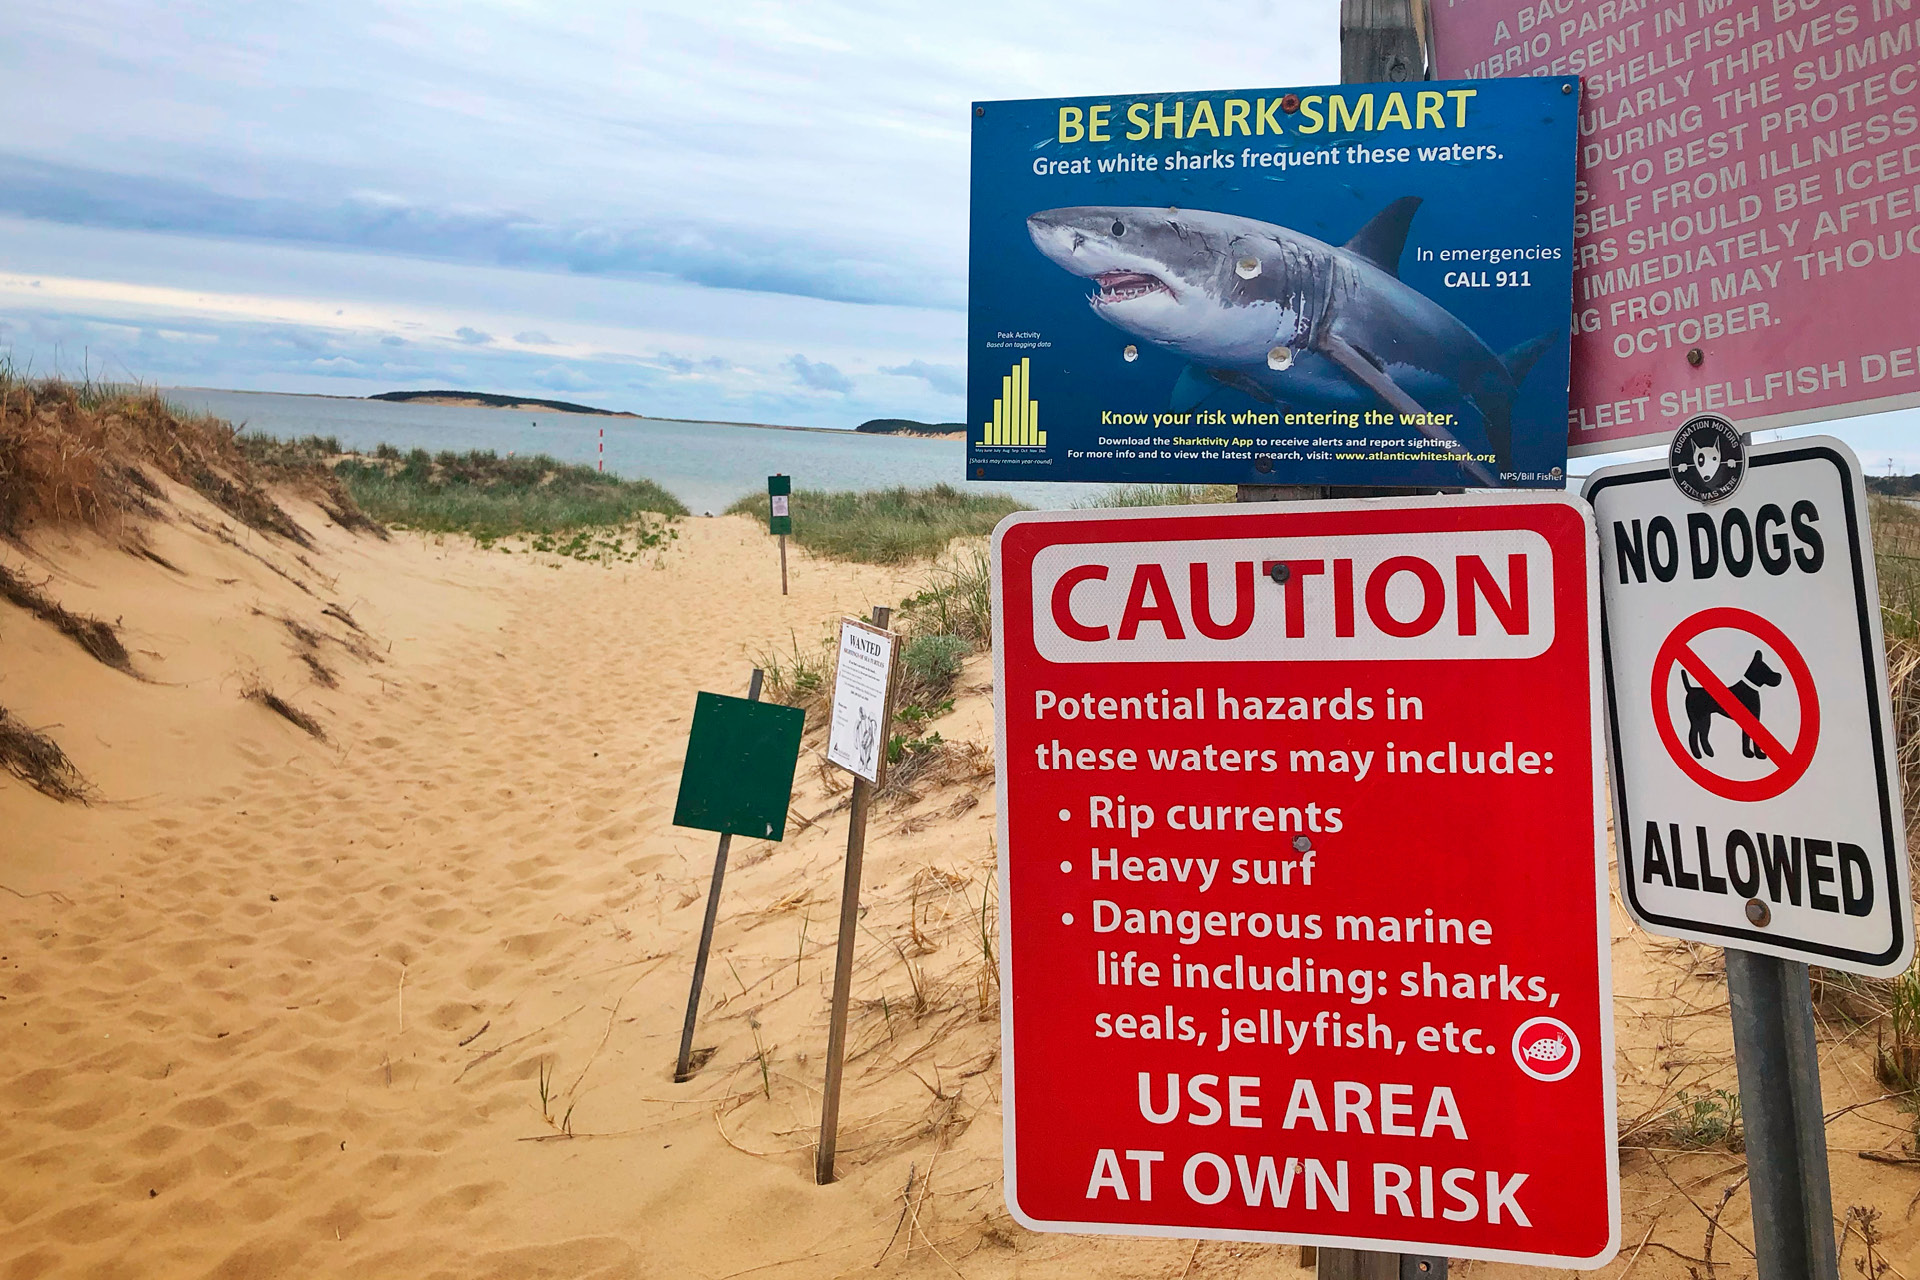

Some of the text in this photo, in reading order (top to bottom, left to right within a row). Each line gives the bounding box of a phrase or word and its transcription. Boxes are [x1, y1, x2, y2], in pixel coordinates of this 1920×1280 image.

[1494, 0, 1585, 46] A BAC
[1518, 2, 1686, 77] RESENT IN
[1465, 32, 1551, 79] VIBRIO
[1579, 70, 1694, 136] ULARLY
[1705, 5, 1859, 86] THRIVES
[1587, 6, 1760, 99] SHELLFISH
[1059, 90, 1476, 143] BE SHARK SMART
[1584, 19, 1920, 170] DURING THE SUMM
[1612, 59, 1920, 191] TO BEST PROTEC
[1033, 144, 1503, 174] Great white sharks frequent these waters.
[1574, 195, 1642, 238] SELF
[1652, 161, 1747, 214] FROM
[1759, 105, 1918, 179] ILLNESS
[1627, 142, 1920, 254] SHOULD BE ICED
[1418, 248, 1433, 261] In
[1440, 245, 1561, 263] emergencies
[1584, 218, 1800, 300] IMMEDIATELY
[1813, 184, 1920, 241] AFTE
[1445, 271, 1530, 287] CALL 911
[1610, 283, 1699, 326] FROM
[1711, 261, 1783, 302] MAY
[1613, 301, 1781, 358] OCTOBER.
[1568, 348, 1920, 433] FLEET SHELLFISH DE
[1099, 437, 1461, 449] Download the Sharktivity App to receive alerts and report sightings.
[1102, 410, 1457, 428] Know your risk when entering the water.
[1674, 420, 1739, 454] DOGNATION MOTORS
[1067, 450, 1496, 464] For more info and to view the latest research, visit: www.atlanticwhiteshark.org
[1500, 472, 1534, 481] NPS/Bill
[1720, 475, 1737, 494] HERE
[1614, 500, 1824, 584] NO DOGS
[1051, 554, 1529, 641] CAUTION
[850, 634, 881, 657] WANTED
[1036, 688, 1422, 720] Potential hazards in
[1035, 740, 1553, 781] these waters may include:
[1090, 795, 1342, 837] Rip currents
[1092, 848, 1316, 892] Heavy surf
[1641, 820, 1875, 918] ALLOWED
[1093, 900, 1492, 944] Dangerous marine
[1098, 951, 1559, 1007] life including: sharks,
[1096, 1006, 1495, 1055] seals, jellyfish, etc.
[1139, 1072, 1468, 1140] USE AREA
[1086, 1149, 1532, 1227] AT OWN RISK
